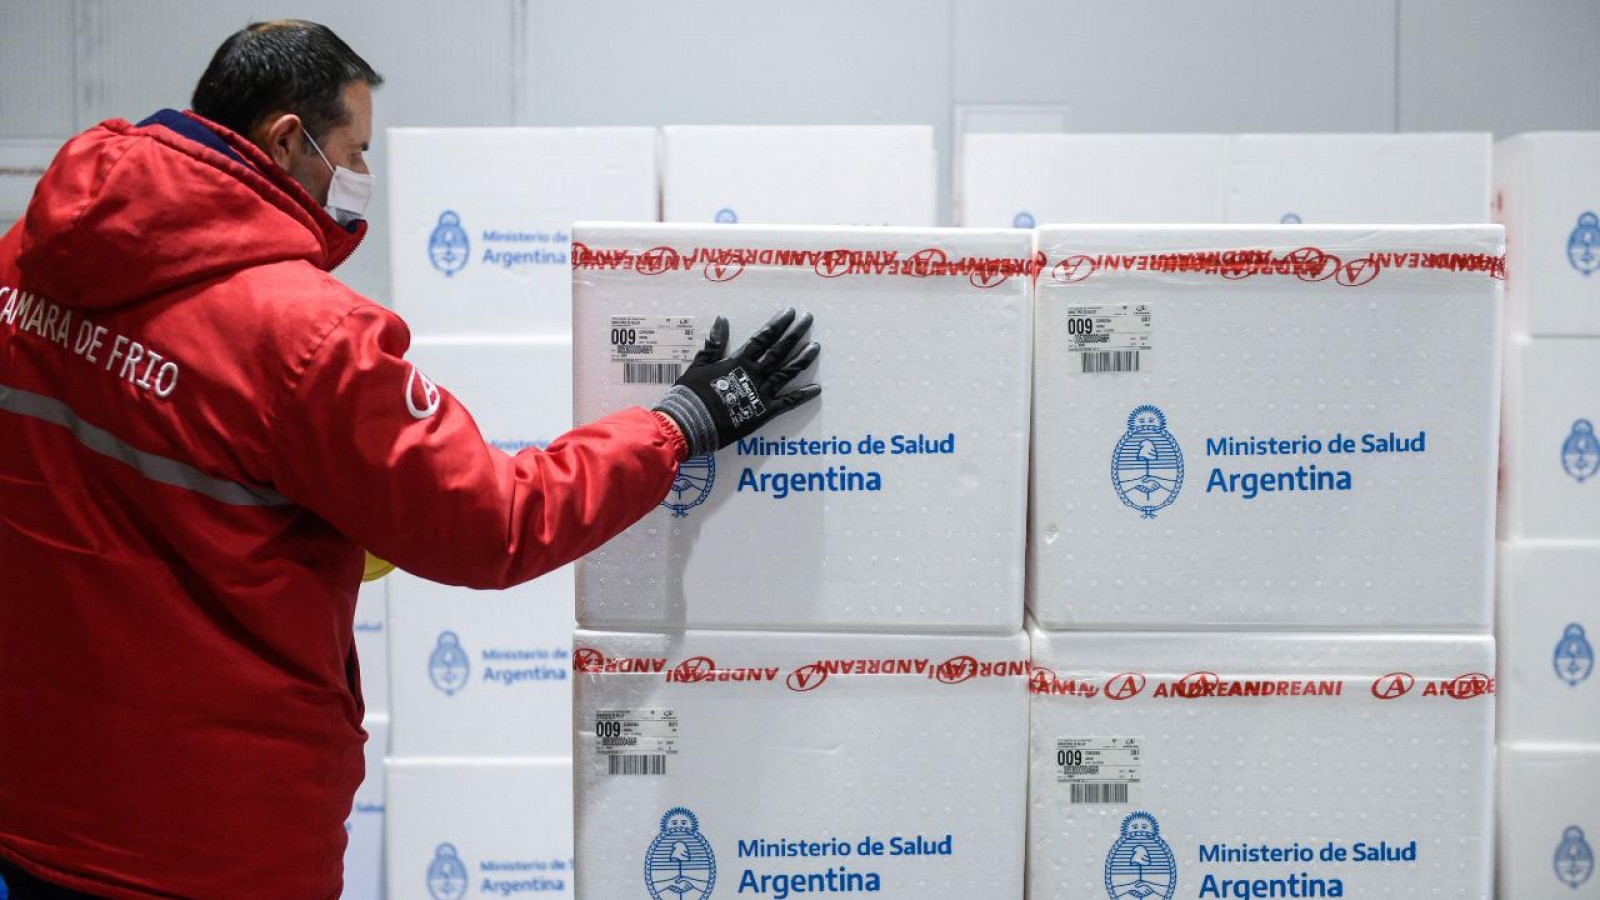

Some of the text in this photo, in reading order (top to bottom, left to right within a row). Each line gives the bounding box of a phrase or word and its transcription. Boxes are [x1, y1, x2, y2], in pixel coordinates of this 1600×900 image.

[482, 229, 568, 242] Ministerio de
[482, 249, 567, 267] Argentina
[610, 328, 638, 346] 009
[1067, 317, 1095, 337] 009
[74, 320, 109, 363] DE
[105, 334, 179, 398] FRIO
[737, 433, 957, 456] Ministerio de Salud
[1206, 431, 1427, 456] Ministerio de Salud
[737, 465, 882, 499] Argentina
[1206, 464, 1353, 499] Argentina
[481, 647, 568, 660] Ministerio de
[483, 666, 567, 684] Argentina
[595, 720, 622, 739] 009
[1056, 749, 1084, 768] 009
[738, 835, 954, 858] Ministerio de Salud
[1199, 840, 1418, 863] Ministerio de Salud
[550, 857, 566, 870] de
[481, 878, 565, 895] Argentina
[738, 866, 881, 900] Argentina
[1199, 872, 1344, 900] Argentina
